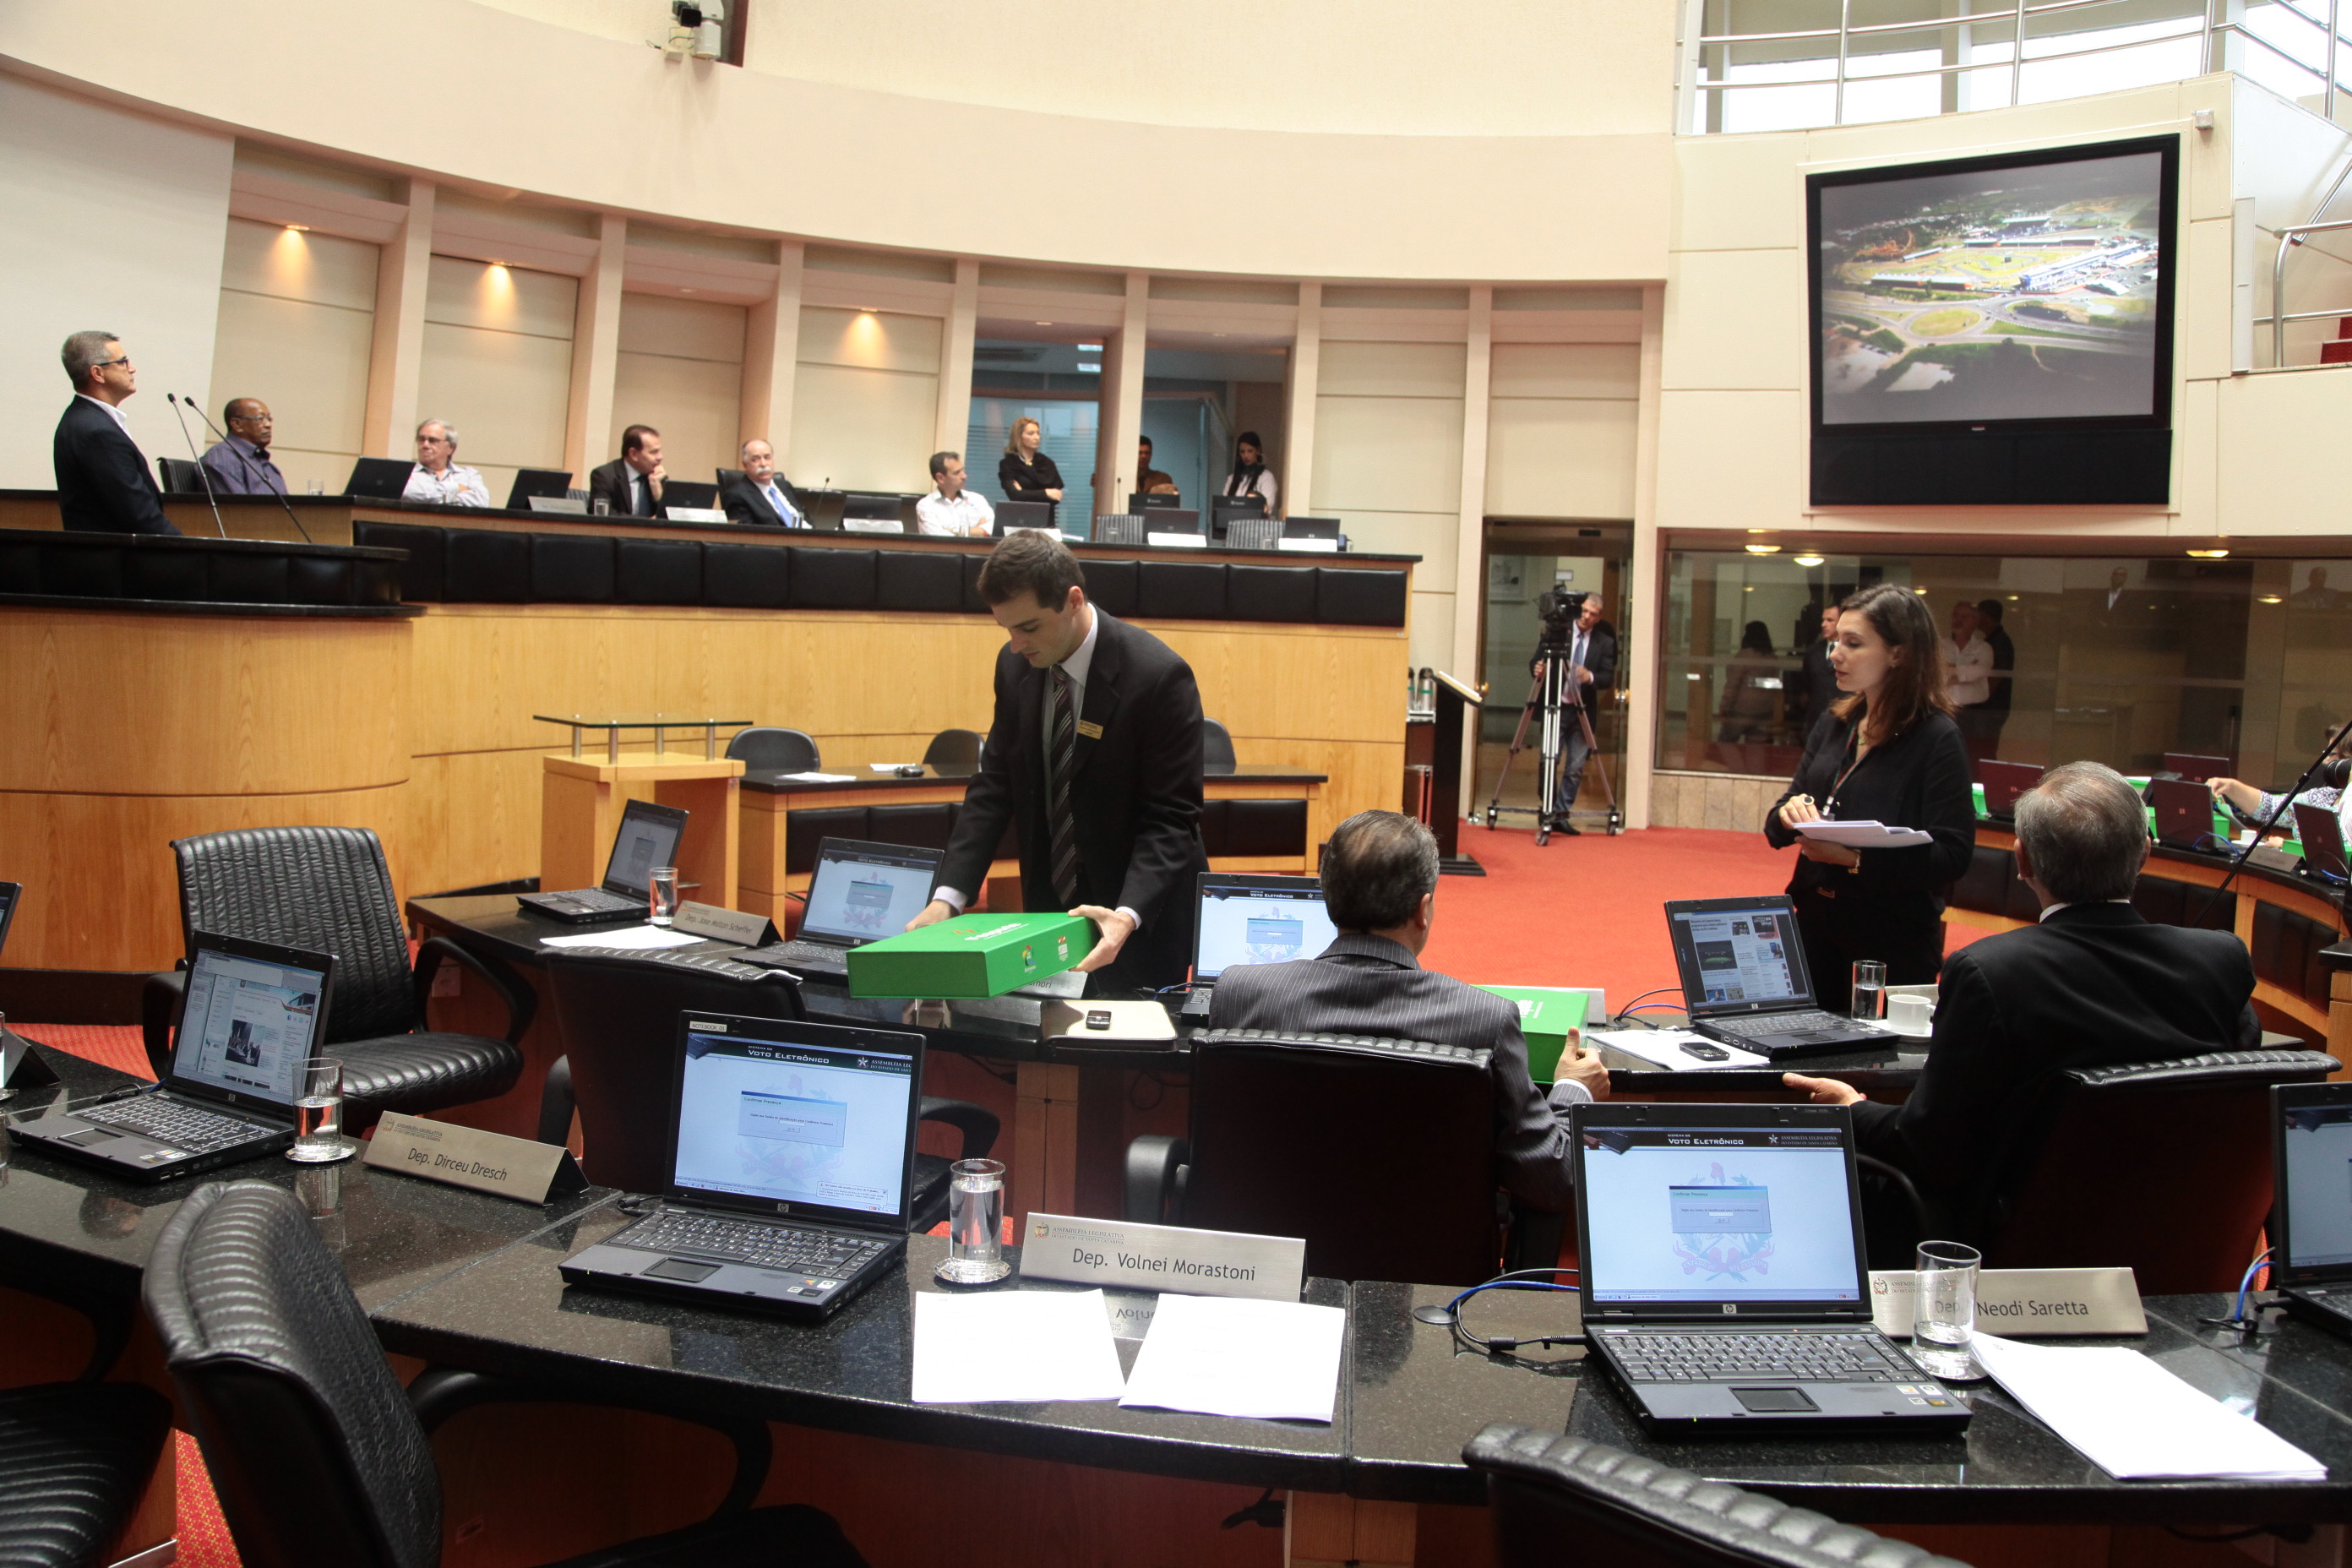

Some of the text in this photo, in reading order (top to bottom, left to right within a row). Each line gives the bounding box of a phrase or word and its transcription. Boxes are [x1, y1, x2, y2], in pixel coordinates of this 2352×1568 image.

[776, 1053, 830, 1064] ELETRÔNICO
[407, 1147, 508, 1181] Dep. Dirceu Dresch
[1072, 1248, 1255, 1282] Dep. Volnei Morastoni
[1977, 1301, 2023, 1316] Neodi
[2029, 1300, 2088, 1315] Saretta
